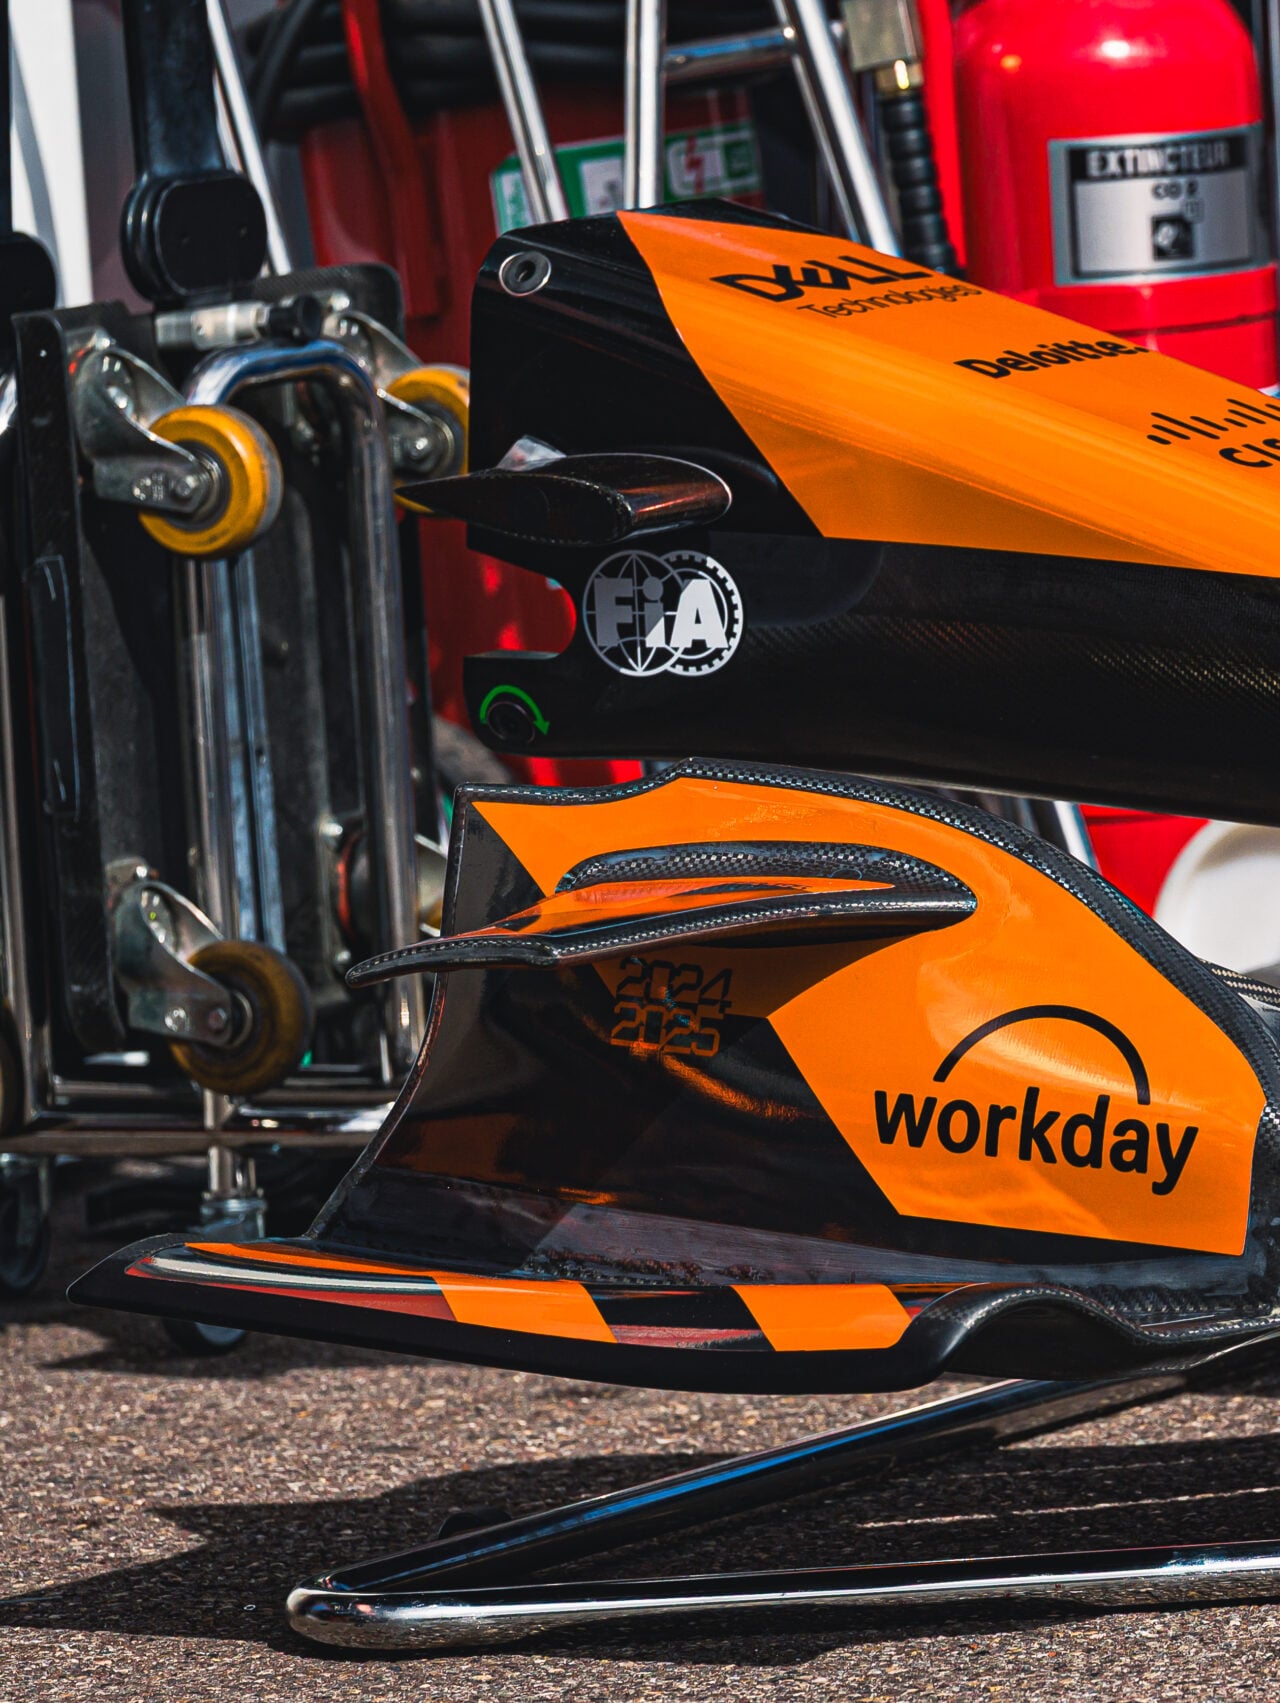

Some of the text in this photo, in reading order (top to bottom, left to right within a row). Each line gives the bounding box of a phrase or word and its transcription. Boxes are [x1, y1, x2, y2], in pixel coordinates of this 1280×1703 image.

[1087, 141, 1230, 177] EXTINCTEUR
[709, 256, 933, 302] DELL
[797, 284, 982, 318] Technologies
[615, 956, 733, 1014] 2024
[609, 1001, 721, 1058] 2025
[873, 1085, 1200, 1197] workday
